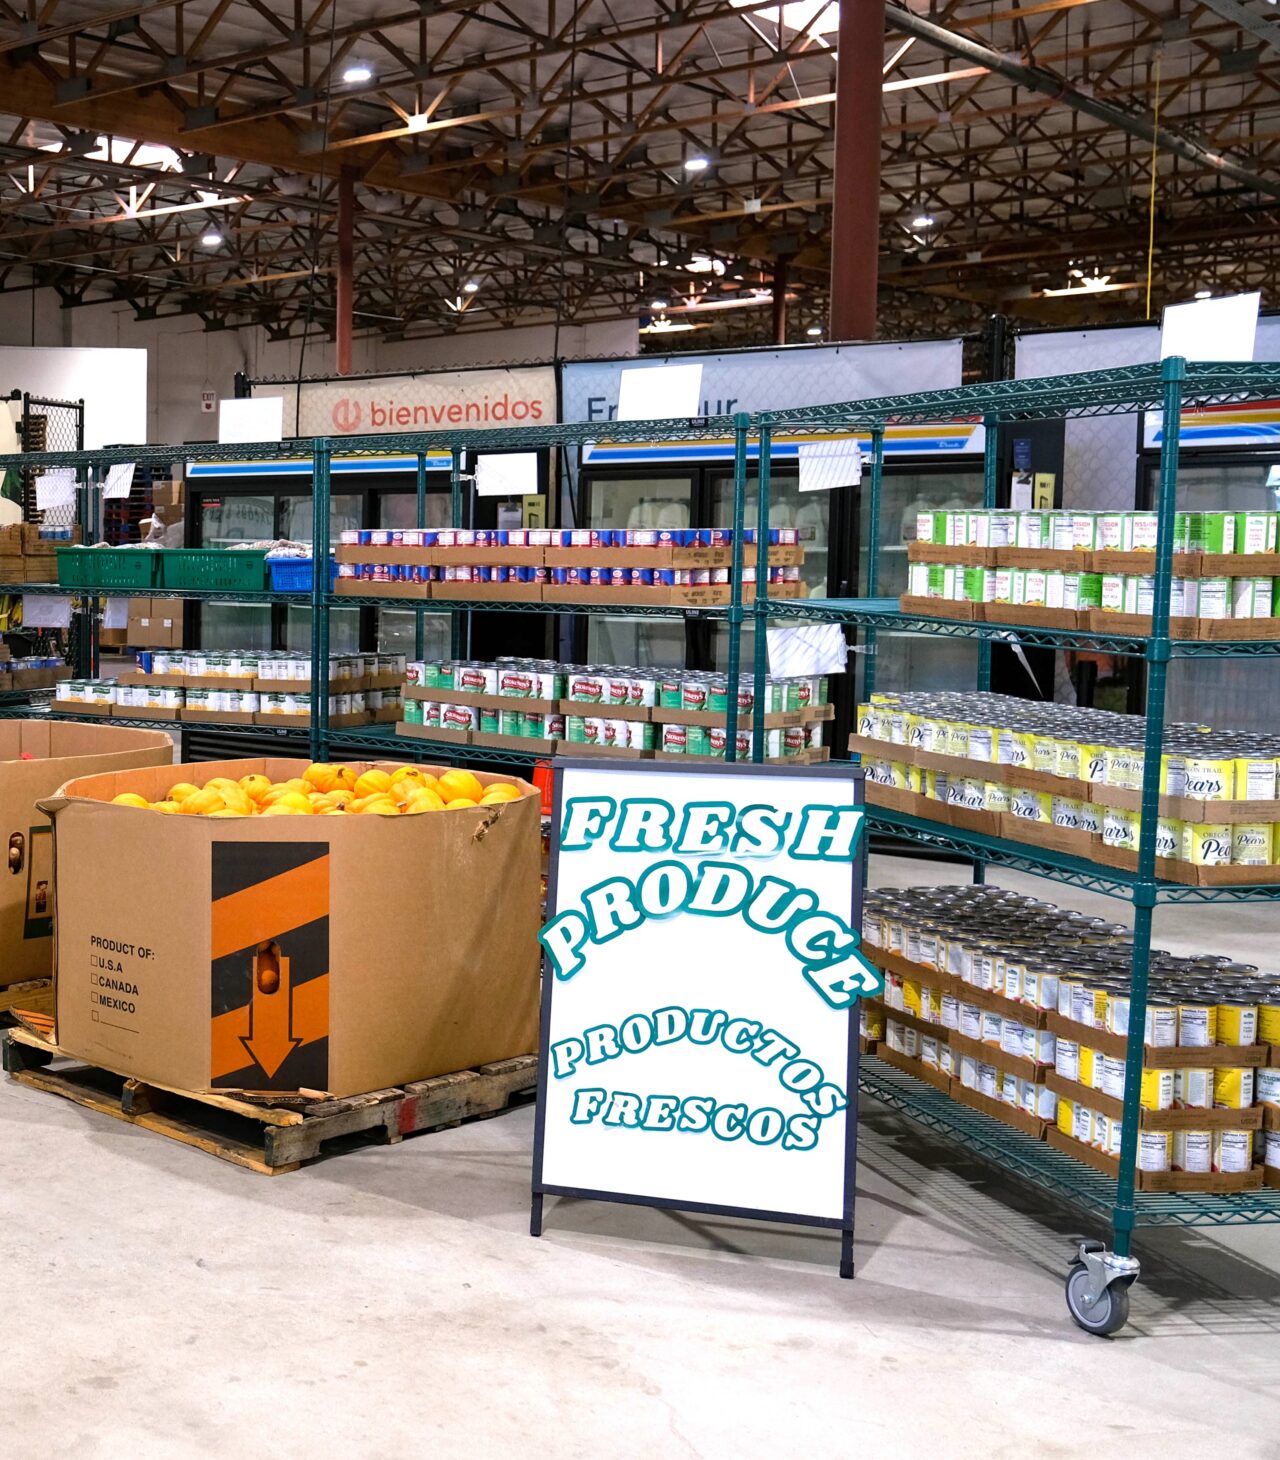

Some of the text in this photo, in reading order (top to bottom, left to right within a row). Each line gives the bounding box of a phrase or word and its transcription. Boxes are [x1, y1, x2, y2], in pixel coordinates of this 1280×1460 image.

[370, 393, 543, 427] bienvenidos
[560, 796, 866, 862] FRESH
[1237, 834, 1266, 846] Pears
[90, 935, 155, 961] PRODUCT OF:
[537, 859, 886, 1010] PRODUCE
[98, 957, 123, 973] U.S.A
[98, 975, 139, 996] CANADA
[99, 994, 136, 1014] MEXICO
[550, 1005, 850, 1119] PRODUCTOS
[570, 1088, 819, 1151] FRESCOS
